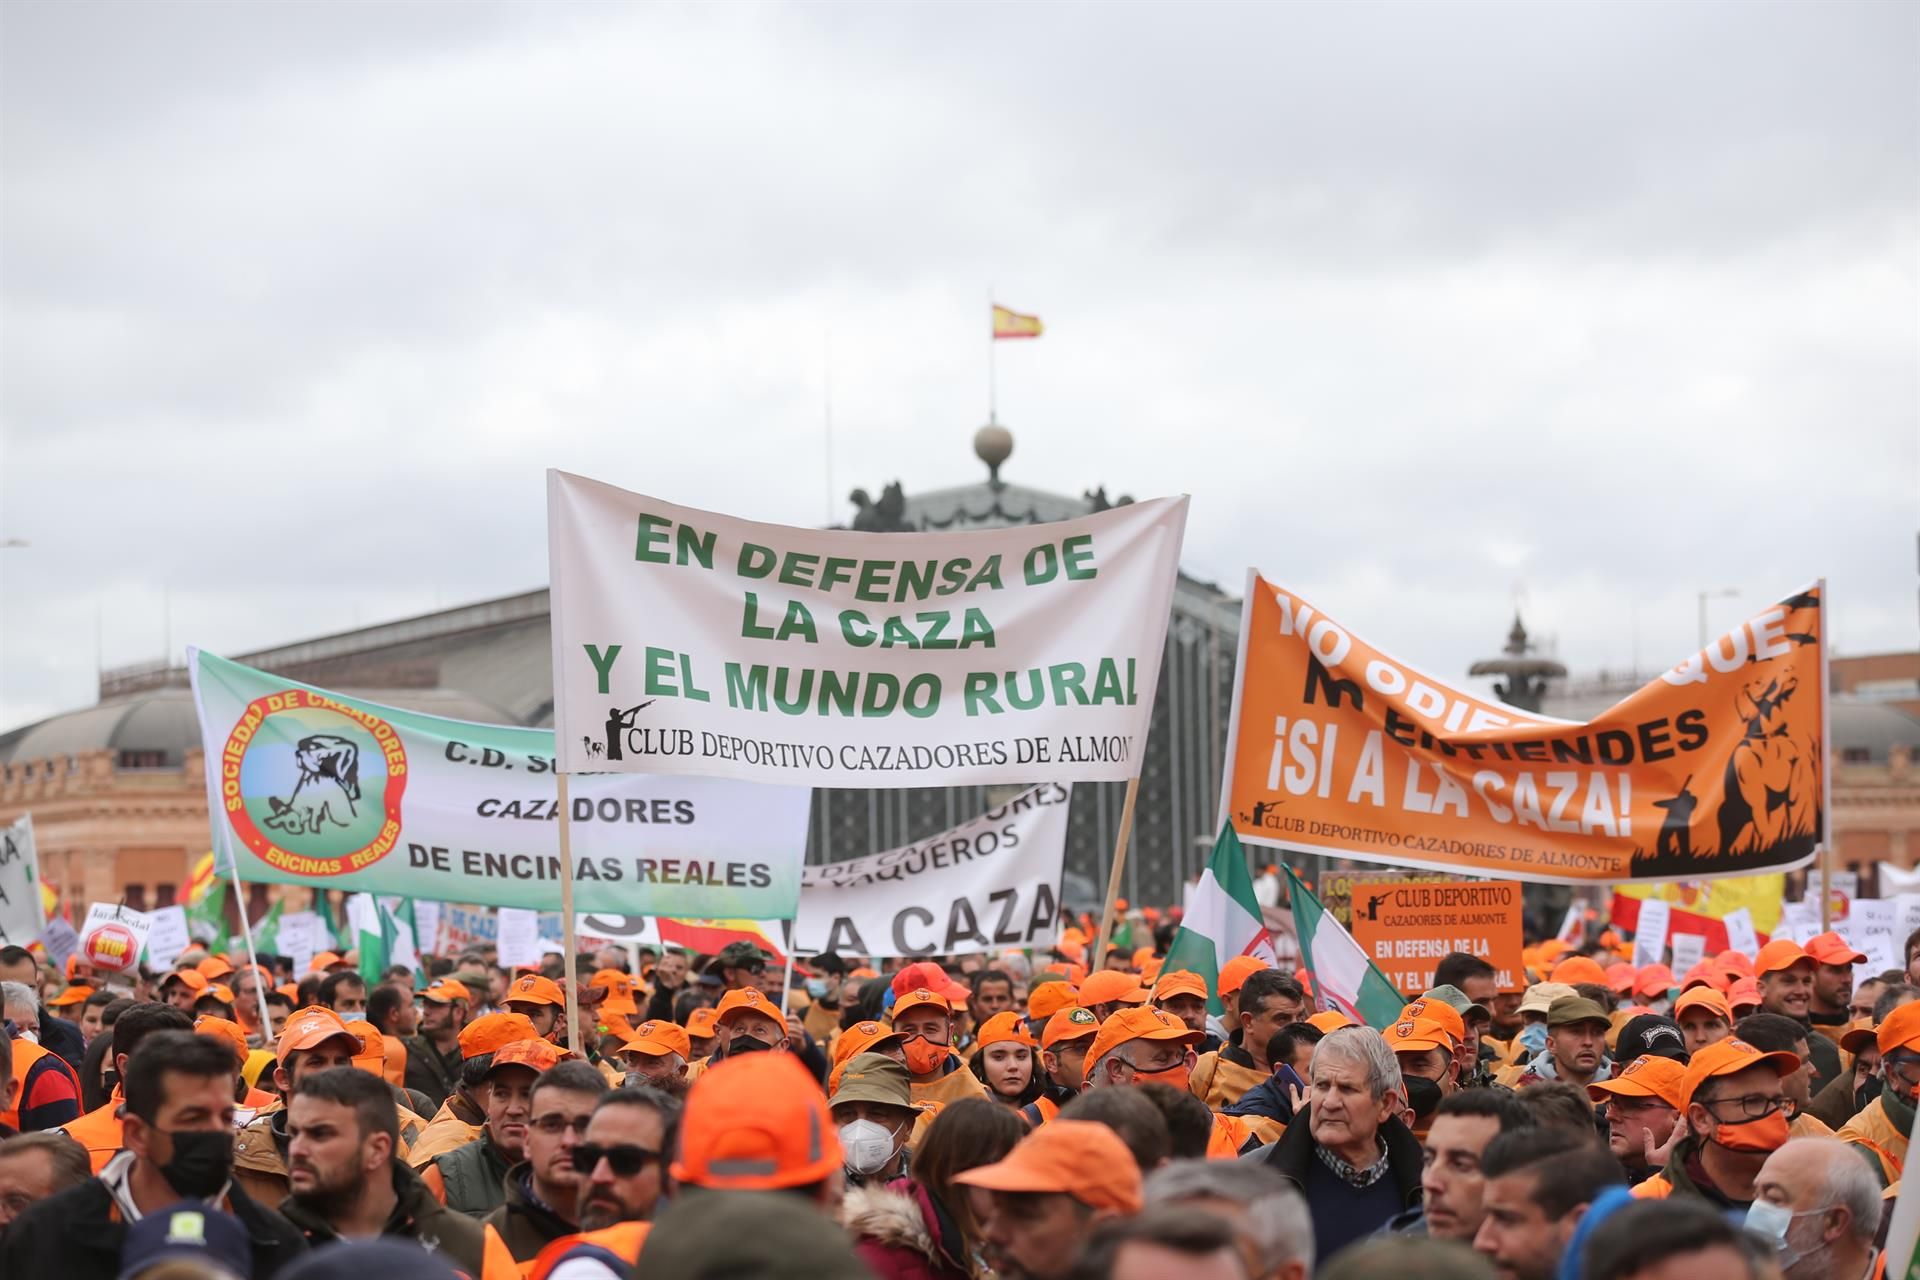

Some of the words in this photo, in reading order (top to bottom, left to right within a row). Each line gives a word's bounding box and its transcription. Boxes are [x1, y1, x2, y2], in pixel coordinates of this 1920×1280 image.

[635, 512, 717, 570] EN
[736, 541, 1004, 604] DEFENSA
[1023, 533, 1099, 586] DE
[741, 592, 819, 645] LA
[837, 607, 998, 650] CAZA
[584, 644, 622, 695] Y
[644, 646, 711, 703] EL
[724, 662, 943, 719] MUNDO
[224, 703, 263, 811] SOCIEDAD
[267, 692, 299, 712] DE
[306, 692, 406, 776] CAZADORES
[444, 740, 514, 772] C.D.
[628, 728, 694, 755] CLUB
[702, 731, 834, 770] DEPORTIVO
[840, 741, 1007, 770] CAZADORES
[1014, 737, 1051, 763] DE
[1347, 730, 1386, 808] A
[1402, 755, 1470, 818] LA
[1472, 768, 1632, 838] CAZA!
[264, 847, 342, 873] ENCINAS
[351, 819, 400, 868] REALES
[408, 843, 452, 872] DE
[636, 857, 771, 888] REALES
[1265, 814, 1306, 833] CLUB
[1309, 821, 1401, 848] DEPORTIVO
[1403, 835, 1507, 860] CAZADORES
[1510, 846, 1536, 862] DE
[1539, 849, 1622, 872] ALMONTE
[891, 883, 1058, 957] CAZA
[1384, 914, 1442, 927] CAZADORES
[1444, 914, 1458, 926] DE
[1459, 913, 1507, 925] ALMONTE
[1395, 889, 1432, 908] CLUB
[1434, 887, 1512, 907] DEPORTIVO
[1376, 940, 1393, 959] EN
[1395, 939, 1451, 958] DEFENSA
[1454, 938, 1472, 957] DE
[1473, 938, 1490, 957] LA
[1394, 971, 1406, 990] Y
[1407, 971, 1423, 990] EL
